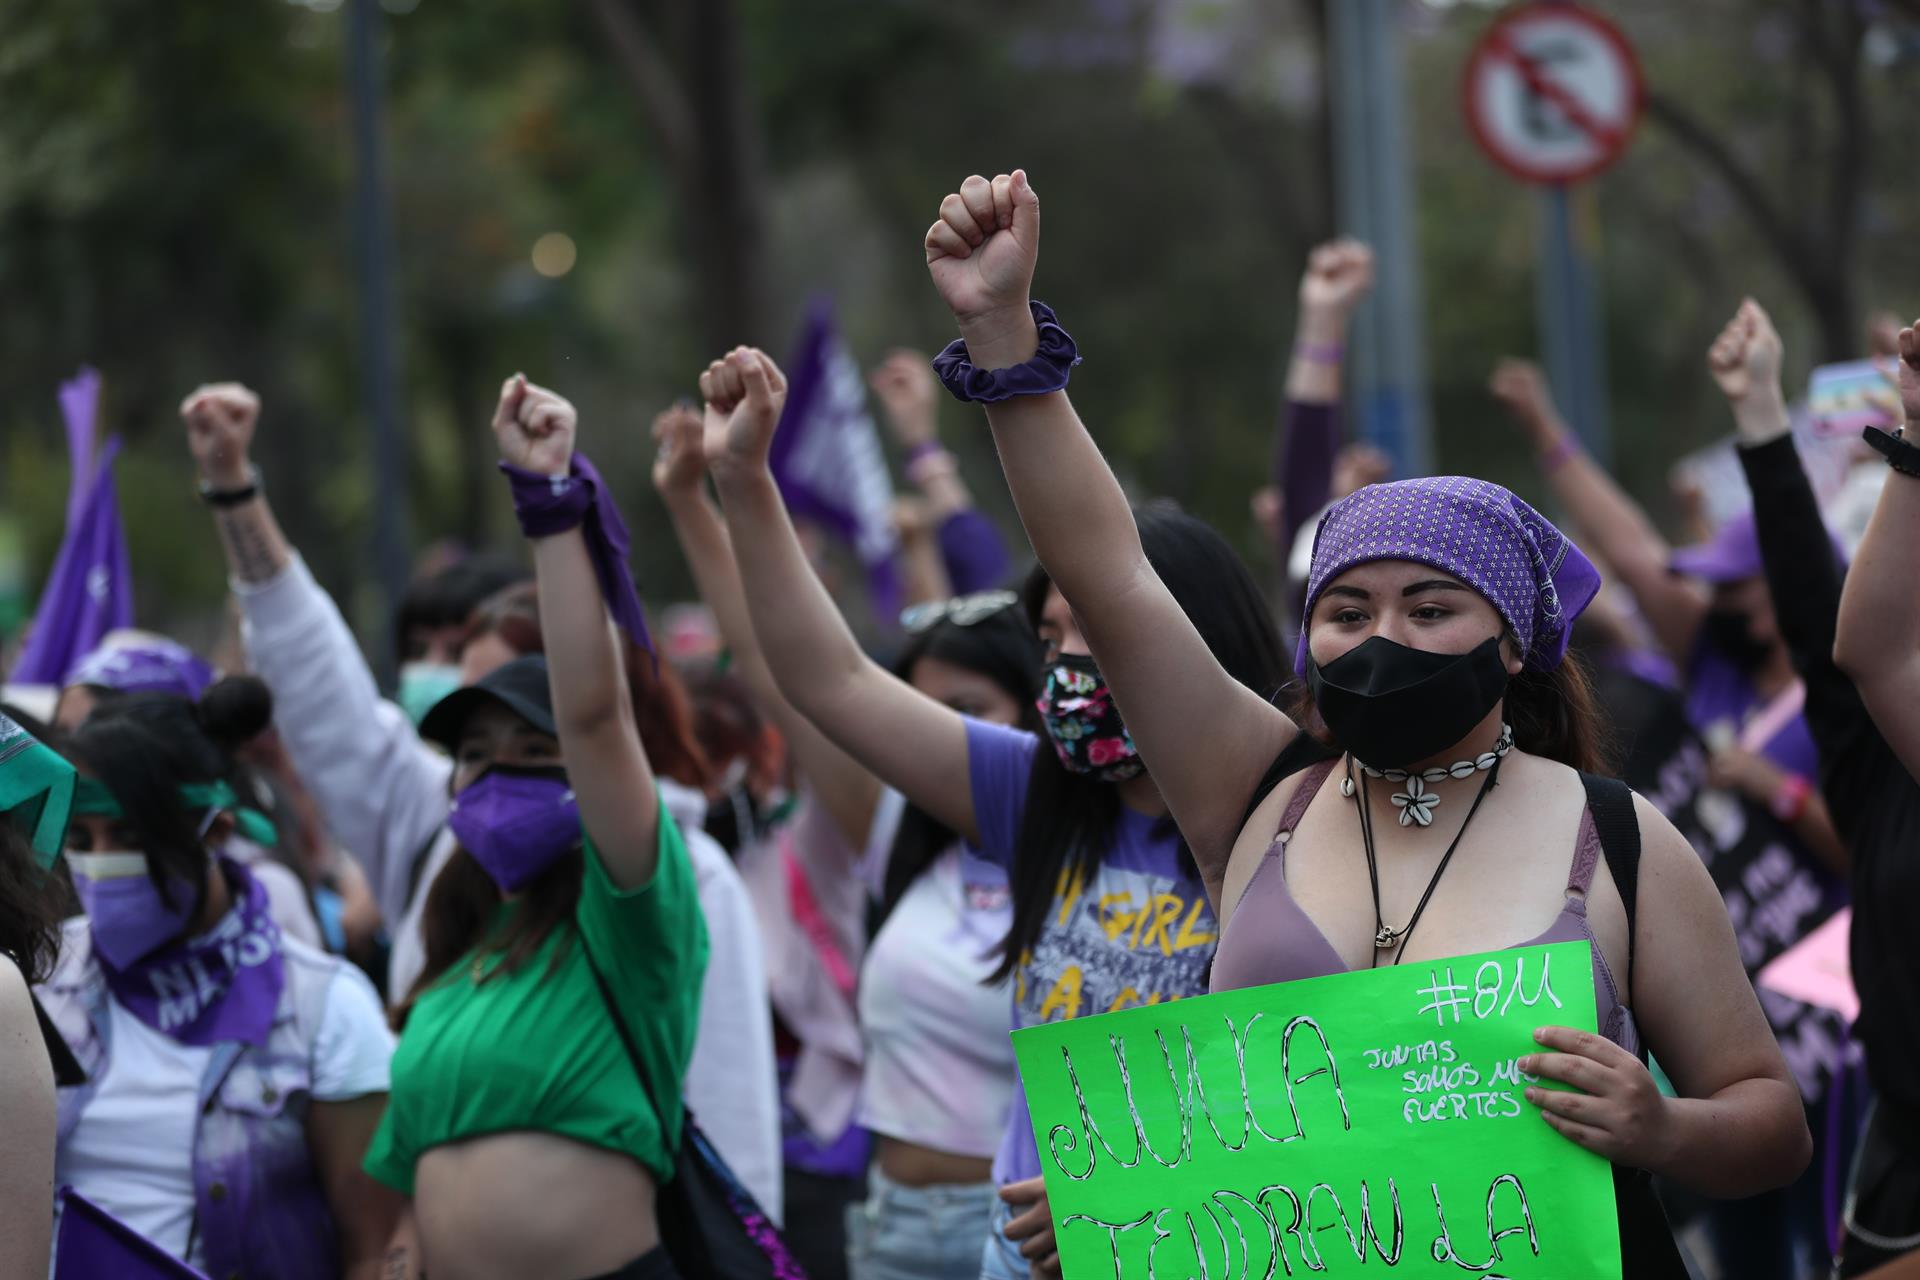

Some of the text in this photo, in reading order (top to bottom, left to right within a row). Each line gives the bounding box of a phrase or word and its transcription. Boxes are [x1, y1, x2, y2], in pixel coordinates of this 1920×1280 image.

[1097, 890, 1218, 958] GIRL
[1416, 952, 1563, 1026] #8M
[1363, 1040, 1458, 1069] JUNTAS
[1402, 1062, 1481, 1093] SOMOS
[1050, 1012, 1351, 1181] NUNCA
[1403, 1091, 1521, 1123] FUERTES
[1431, 1174, 1539, 1270] LA
